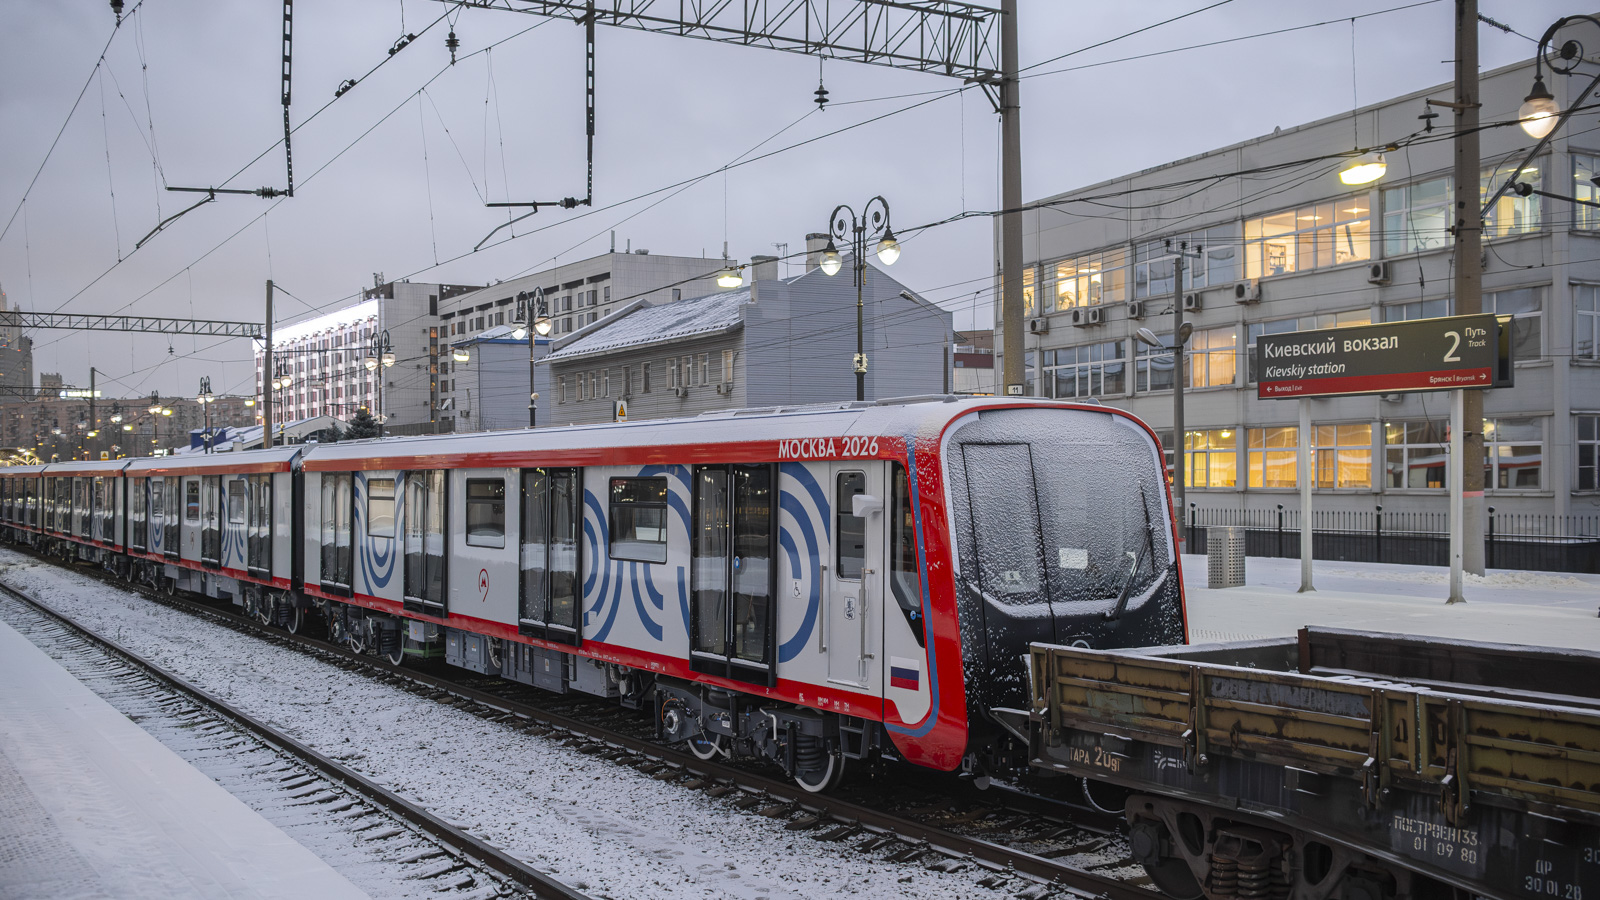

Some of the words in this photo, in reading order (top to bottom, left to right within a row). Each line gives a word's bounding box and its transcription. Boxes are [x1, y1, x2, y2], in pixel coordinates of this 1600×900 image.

[1465, 327, 1487, 338] Путь
[1264, 336, 1336, 358] Киевский
[1343, 336, 1399, 353] вокзал
[1443, 331, 1461, 362] 2
[1468, 339, 1487, 348] Track
[1265, 363, 1307, 378] Kievskiy
[1308, 362, 1346, 376] station
[1429, 376, 1453, 384] Брянск
[1012, 386, 1019, 394] 11
[778, 438, 836, 458] МОСКВА
[841, 436, 879, 457] 2026
[1069, 747, 1090, 765] ТАРА
[1414, 836, 1427, 852] 01
[1436, 842, 1454, 858] 09
[1460, 848, 1477, 864] 80
